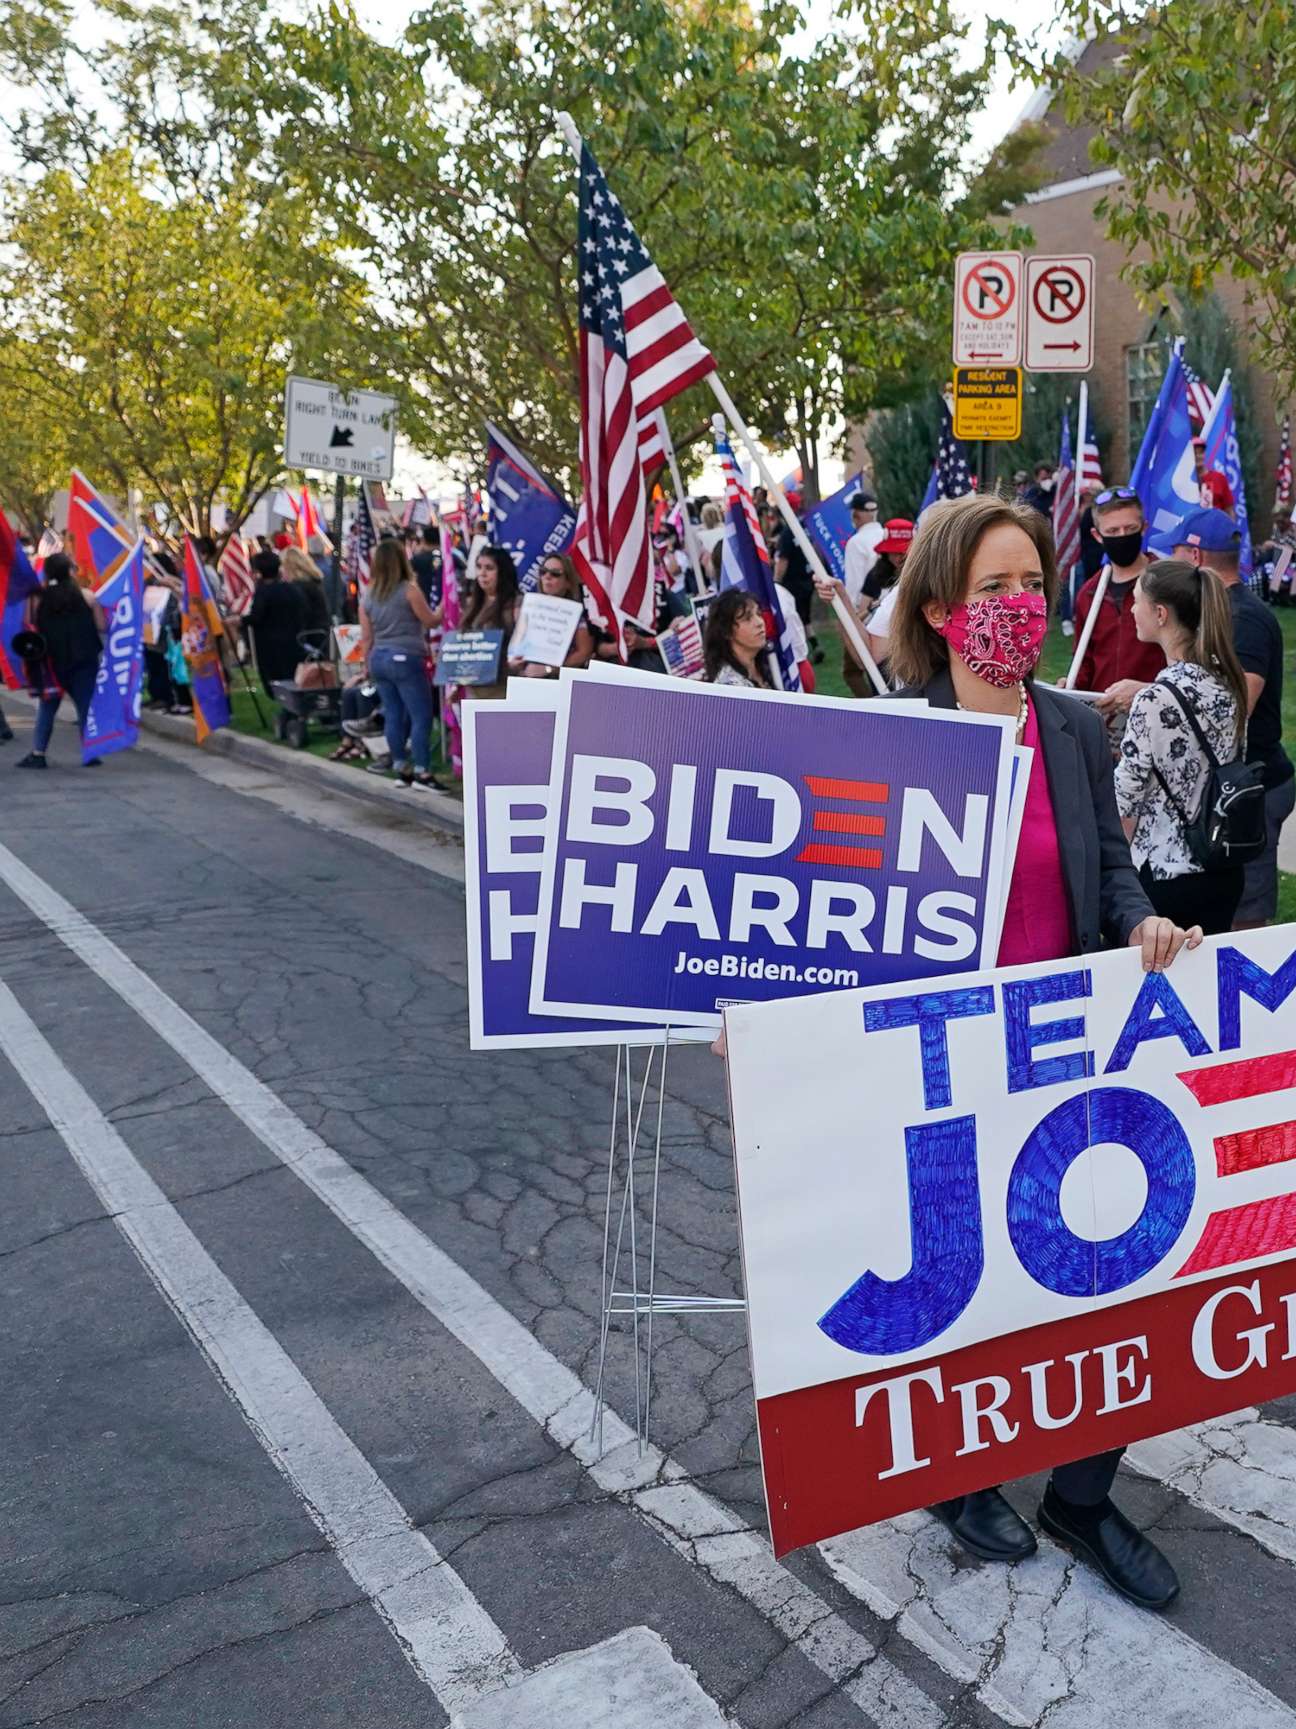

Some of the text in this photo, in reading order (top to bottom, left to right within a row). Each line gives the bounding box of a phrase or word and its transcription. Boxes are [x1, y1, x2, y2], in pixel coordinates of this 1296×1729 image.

[958, 383, 1017, 394] PARKING AREA
[968, 371, 1007, 382] RESIDENT
[295, 400, 385, 427] RIGHT TURN LAN
[300, 451, 331, 466] YIELD
[565, 754, 989, 879] BIDEN
[559, 858, 978, 963] HARRIS
[674, 951, 860, 987] JoeBiden.com
[855, 1334, 1152, 1481] TRUE
